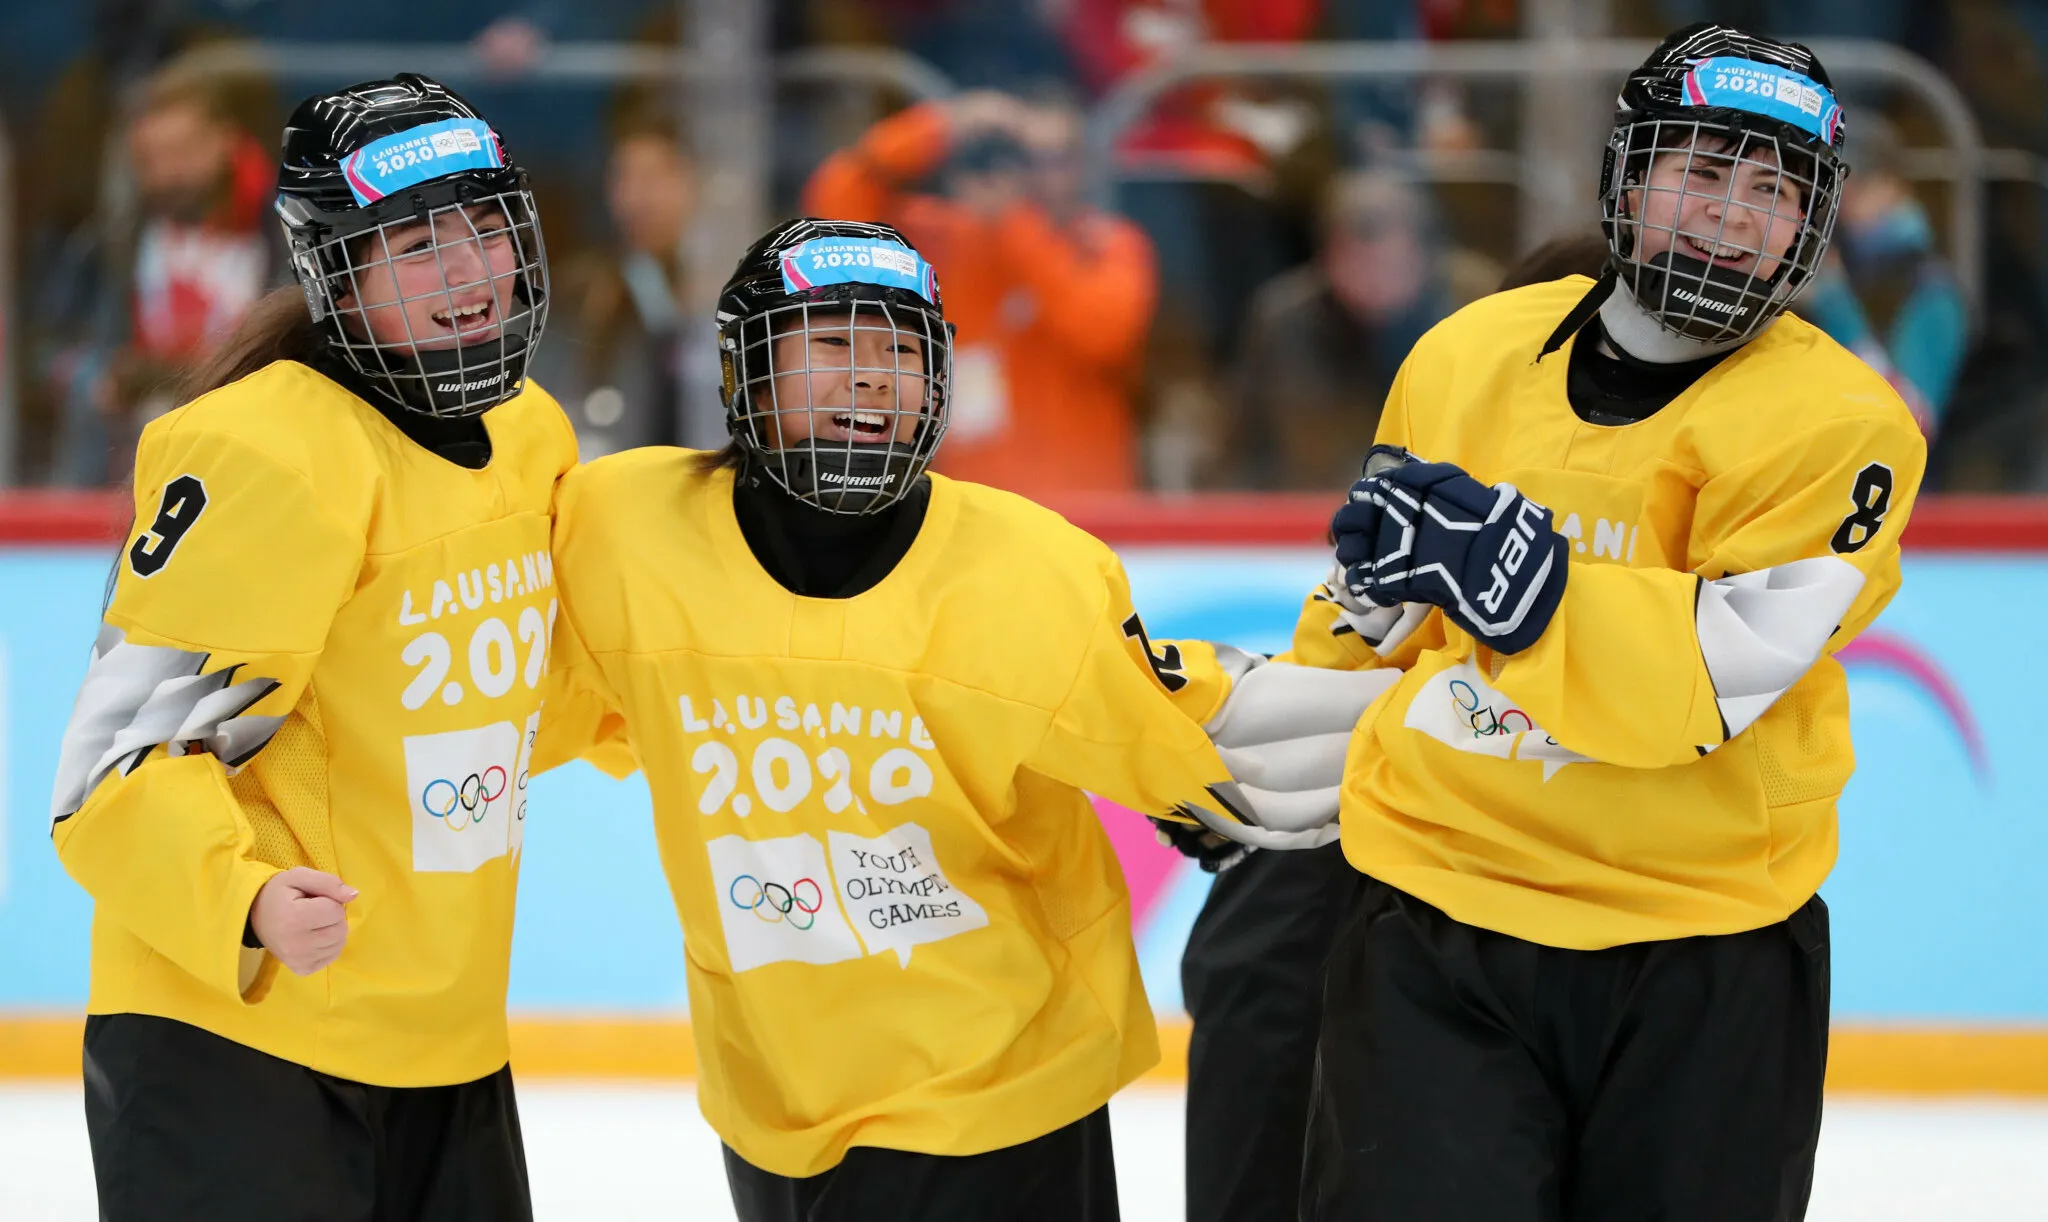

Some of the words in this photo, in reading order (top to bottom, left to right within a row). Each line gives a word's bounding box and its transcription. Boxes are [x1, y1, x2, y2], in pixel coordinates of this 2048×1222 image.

[1716, 67, 1777, 84] LAUSANNE
[371, 136, 429, 162] LAUSANNE
[810, 245, 870, 255] LAUSANNE
[1672, 287, 1749, 317] WARRIOR
[437, 369, 511, 393] WARRIOR
[820, 472, 896, 486] WARRIOR
[1828, 460, 1894, 555] 8
[129, 472, 210, 580] 9
[1476, 497, 1546, 615] UER
[398, 549, 553, 626] LAUSANN
[678, 694, 936, 750] LAUSANNE
[846, 872, 949, 900] OLYMPI
[868, 900, 962, 929] GAMES
